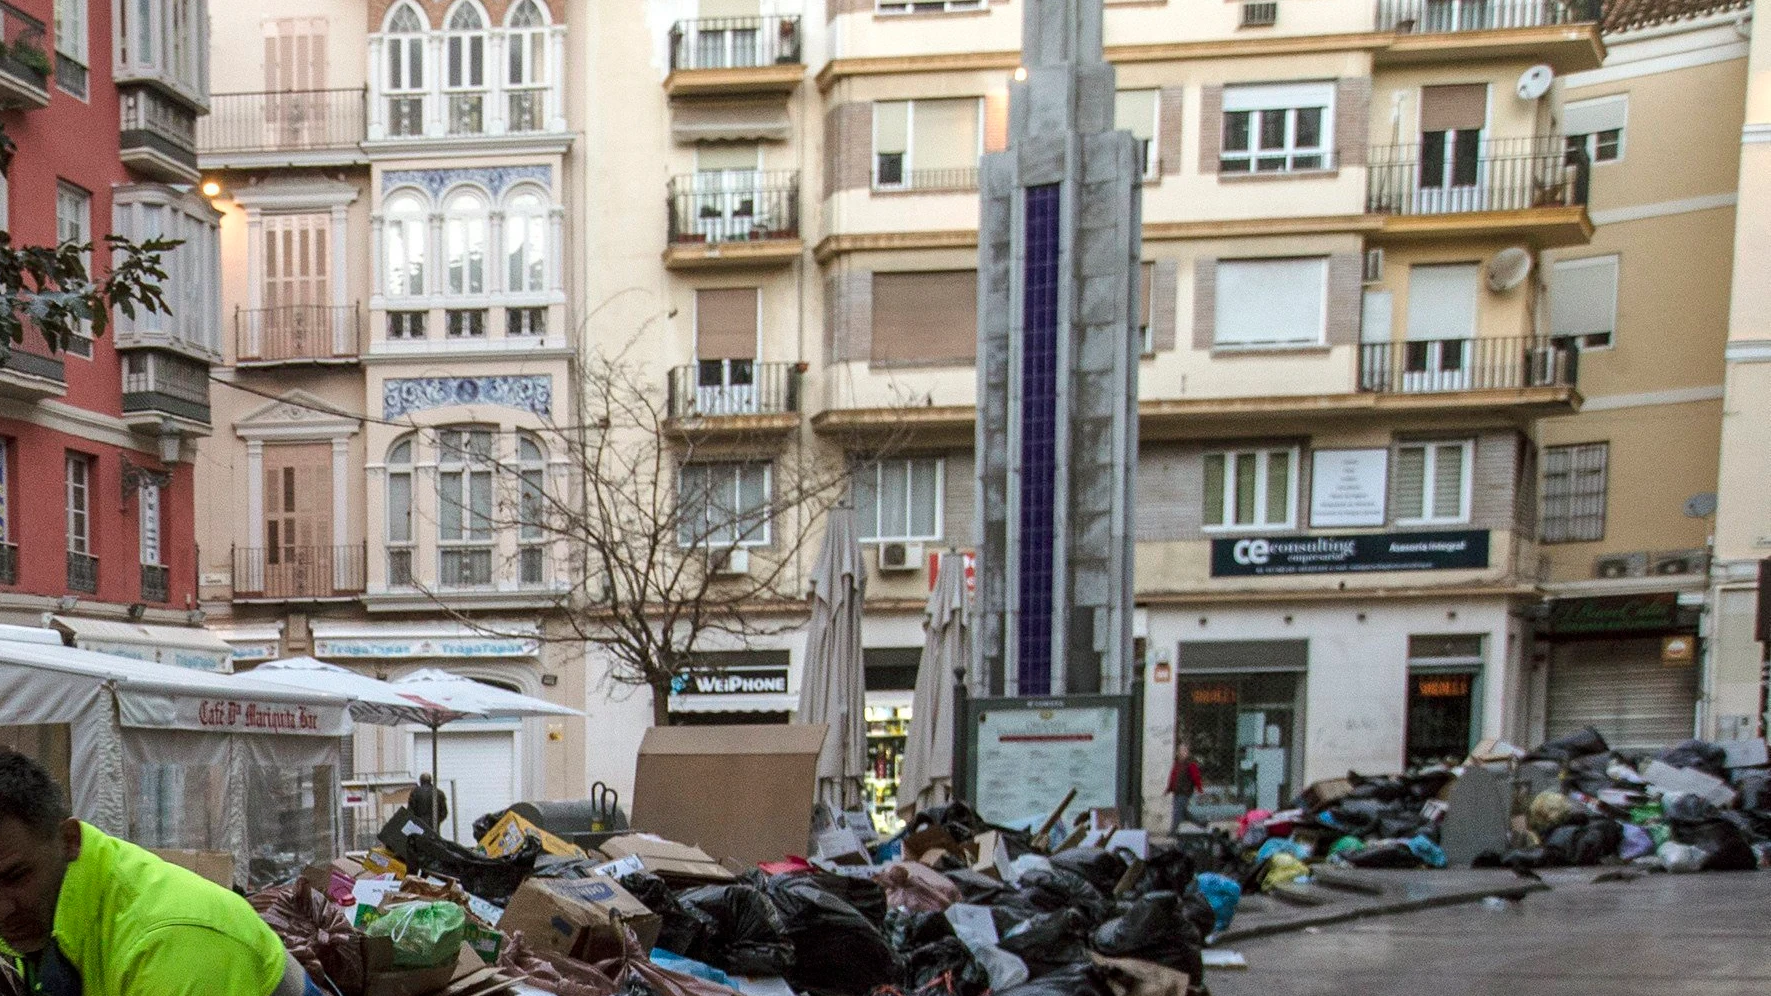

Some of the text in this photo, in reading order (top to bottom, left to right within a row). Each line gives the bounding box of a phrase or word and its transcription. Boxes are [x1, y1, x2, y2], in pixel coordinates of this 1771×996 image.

[1270, 537, 1356, 556] consulting
[245, 703, 295, 734] Mariquita
[298, 704, 318, 730] Bar
